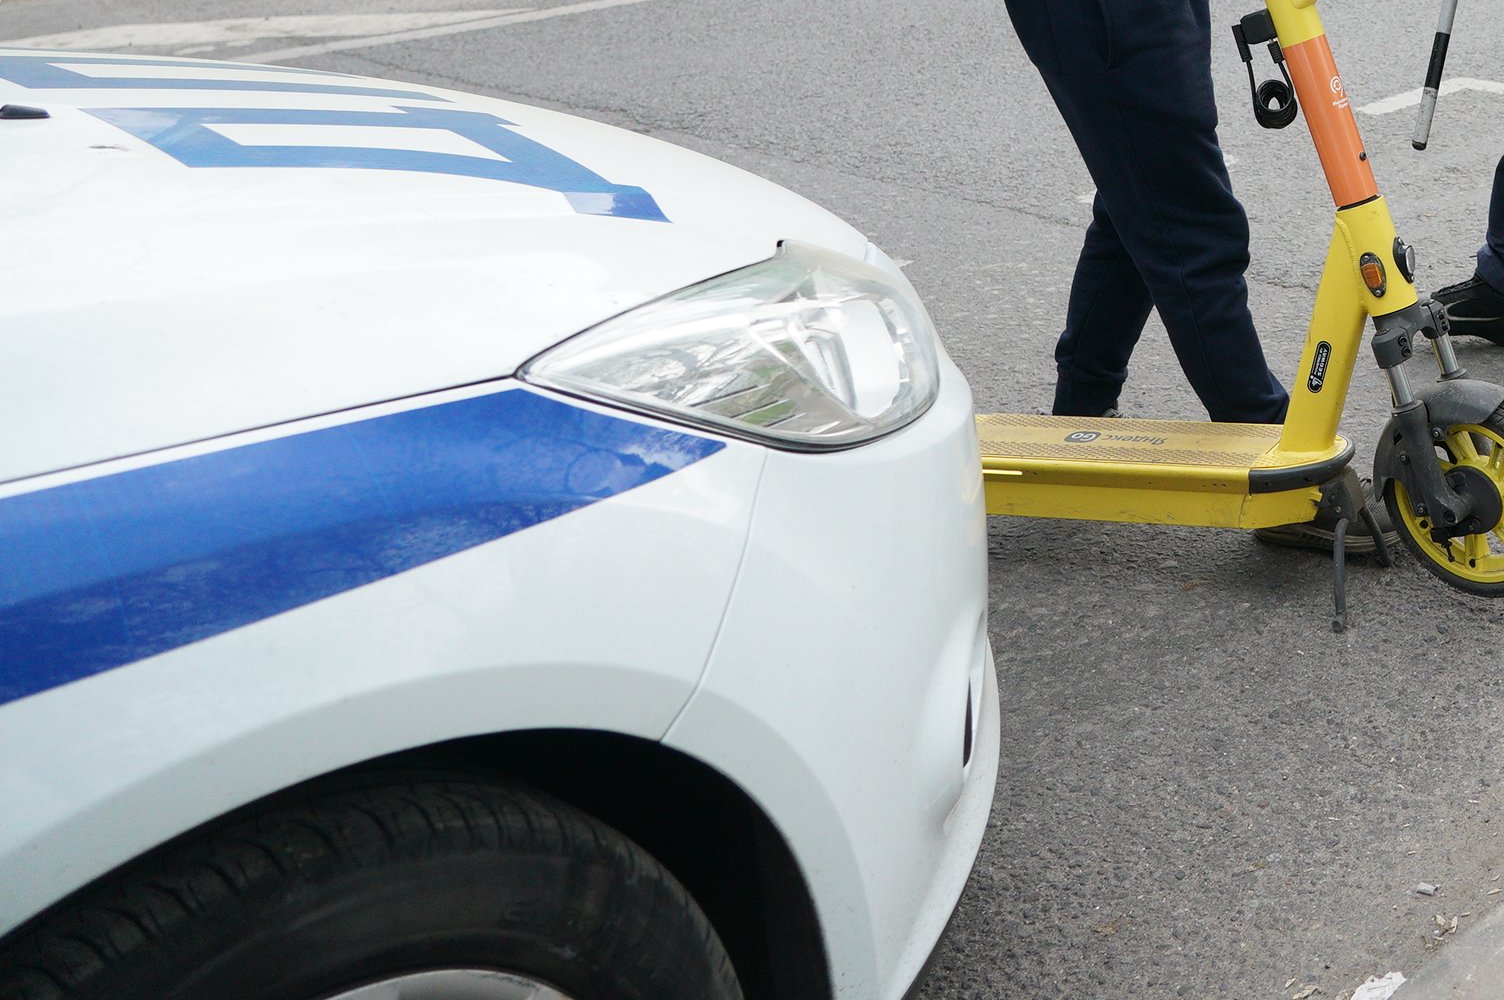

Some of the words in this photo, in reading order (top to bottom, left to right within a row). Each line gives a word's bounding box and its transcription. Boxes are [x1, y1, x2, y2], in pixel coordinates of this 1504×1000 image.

[1317, 347, 1328, 377] SEGWAY
[1067, 432, 1098, 442] Go
[1101, 434, 1169, 445] Яндекс
